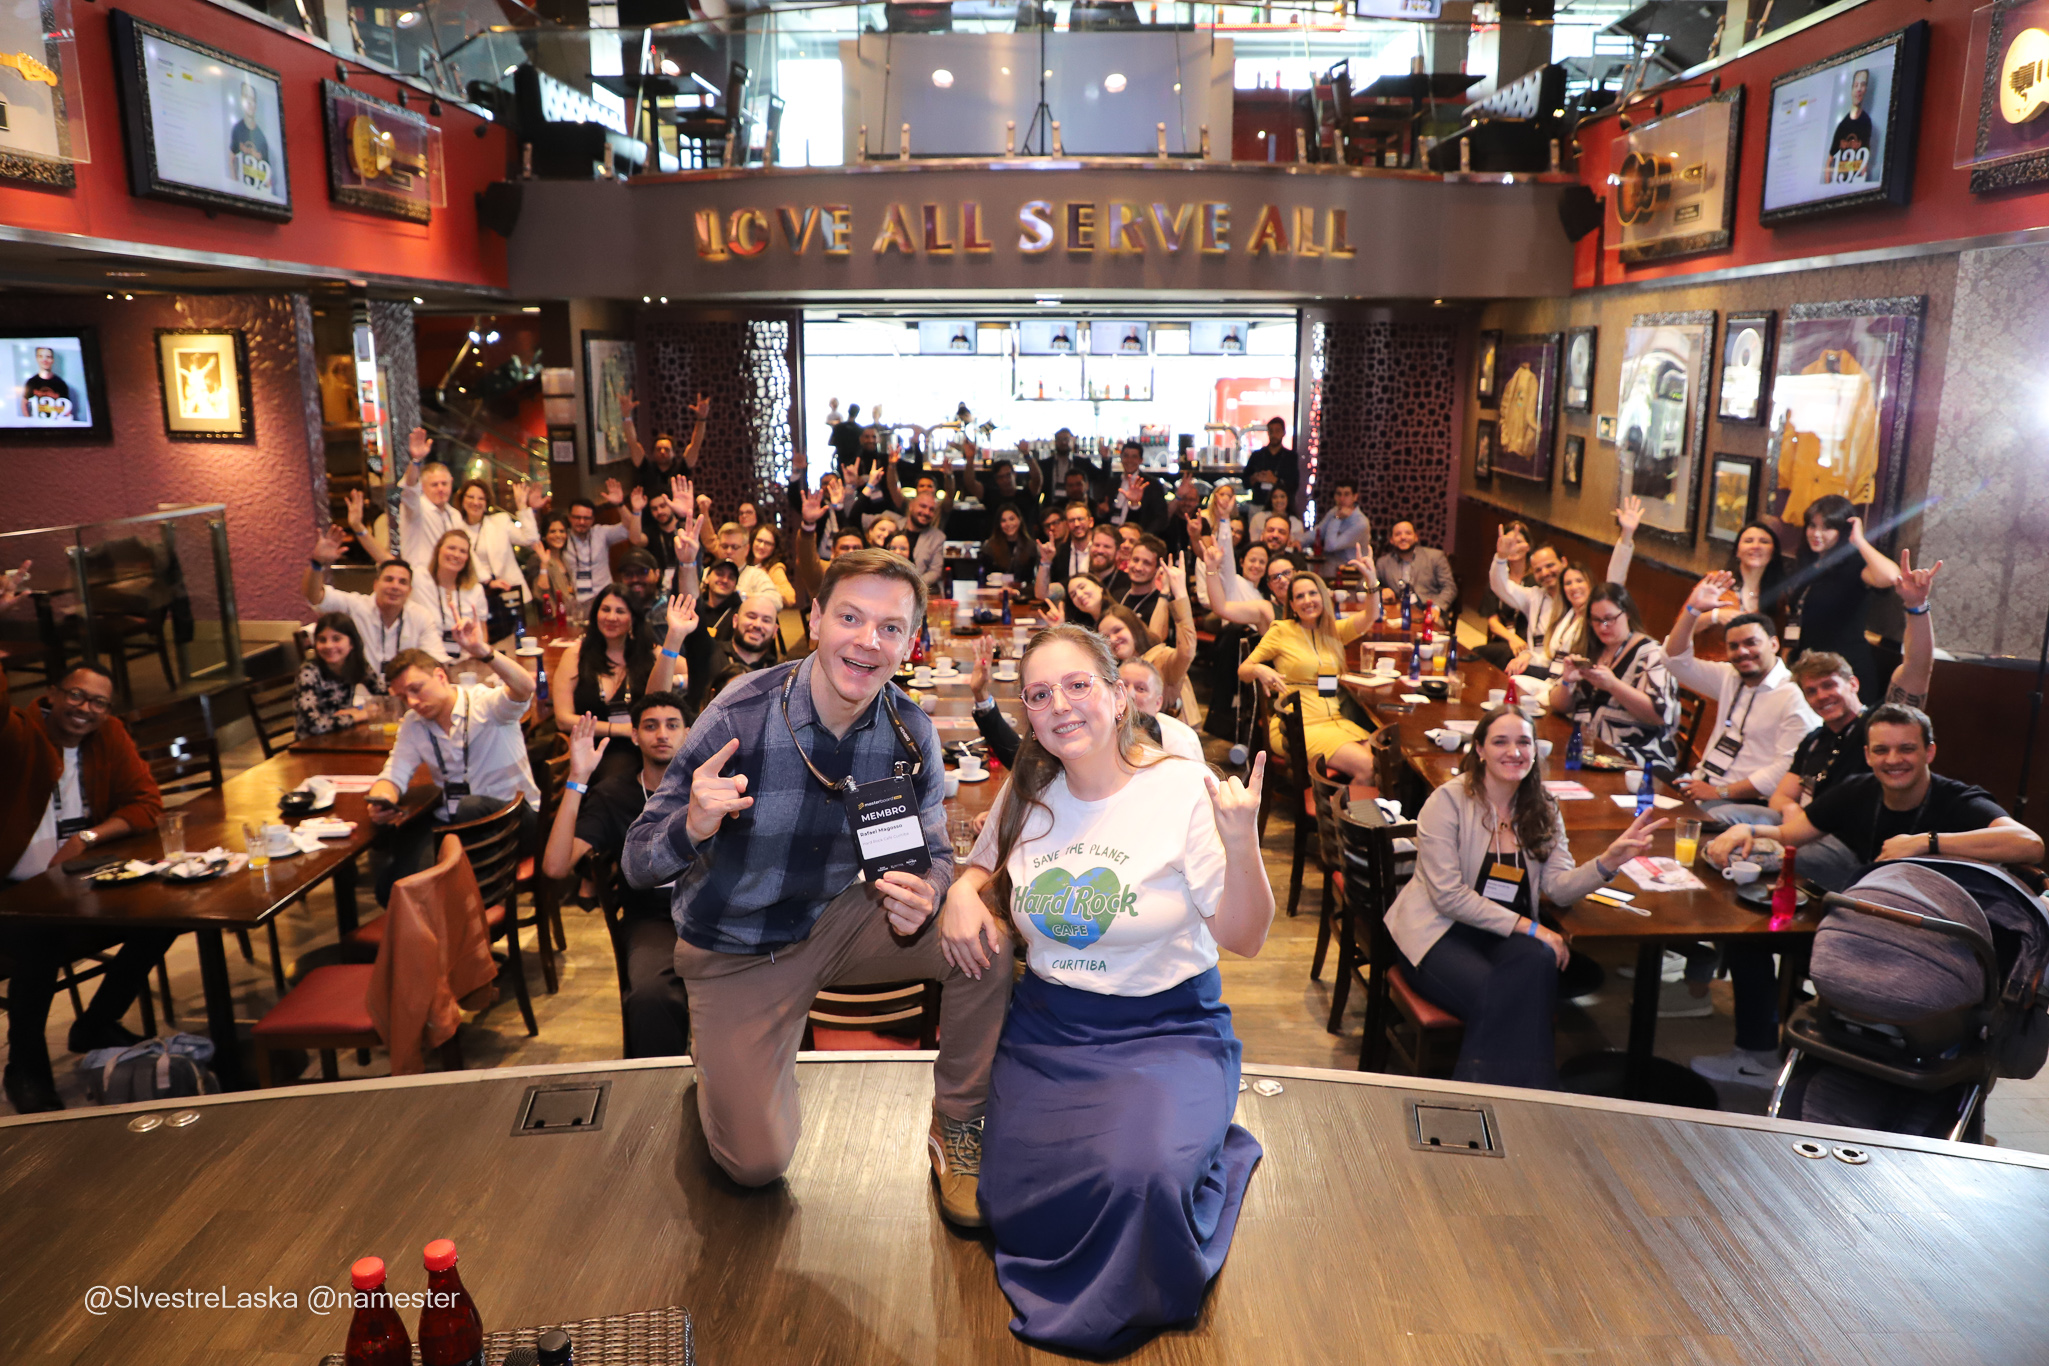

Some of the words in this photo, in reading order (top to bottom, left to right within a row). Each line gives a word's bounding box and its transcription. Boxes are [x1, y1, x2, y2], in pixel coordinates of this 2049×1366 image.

[235, 151, 272, 190] 132
[1832, 147, 1869, 184] 132
[694, 204, 852, 261] LOVE
[872, 202, 992, 254] ALL
[1018, 200, 1231, 253] SERVE
[1247, 204, 1357, 258] ALL
[28, 396, 73, 420] 132
[861, 805, 906, 822] MEMBRO
[860, 828, 877, 837] Rafael
[878, 824, 903, 832] Magosso
[1033, 850, 1060, 868] SAVE
[1065, 843, 1084, 855] THE
[1089, 844, 1130, 865] PLANET
[1013, 885, 1073, 915] Hard
[1071, 884, 1138, 921] Rock
[1052, 925, 1088, 936] CAFE
[1052, 959, 1107, 972] CURITIBA
